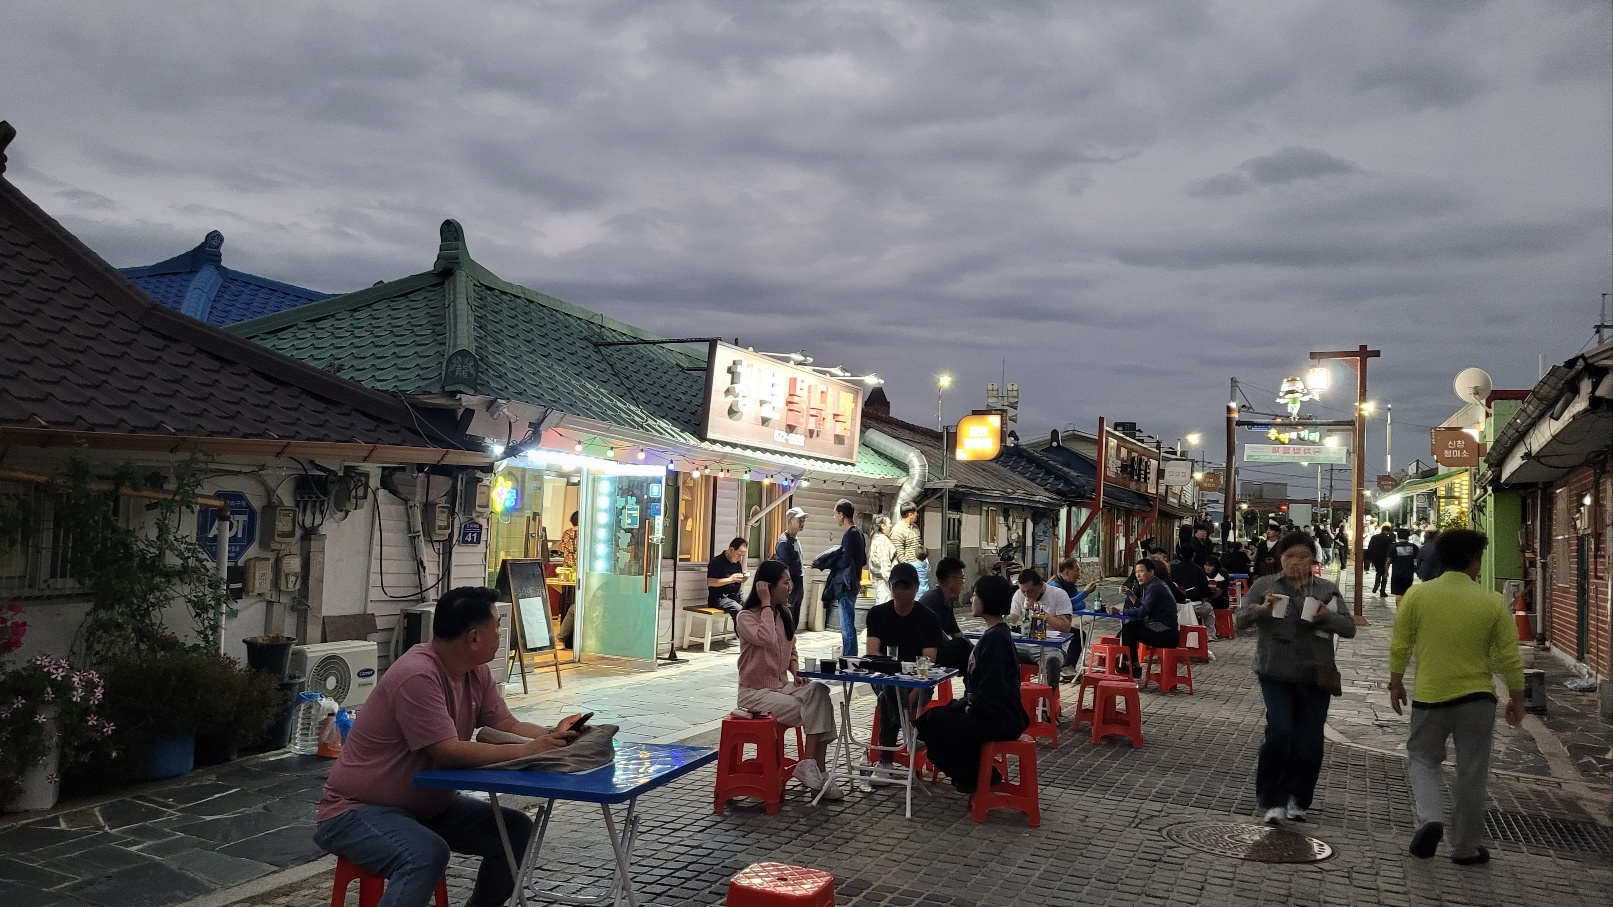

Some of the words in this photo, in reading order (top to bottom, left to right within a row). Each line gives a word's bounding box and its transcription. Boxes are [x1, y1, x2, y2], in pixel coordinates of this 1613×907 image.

[1447, 440, 1465, 449] 신창
[1443, 450, 1469, 458] 정미소
[464, 532, 477, 543] 41
